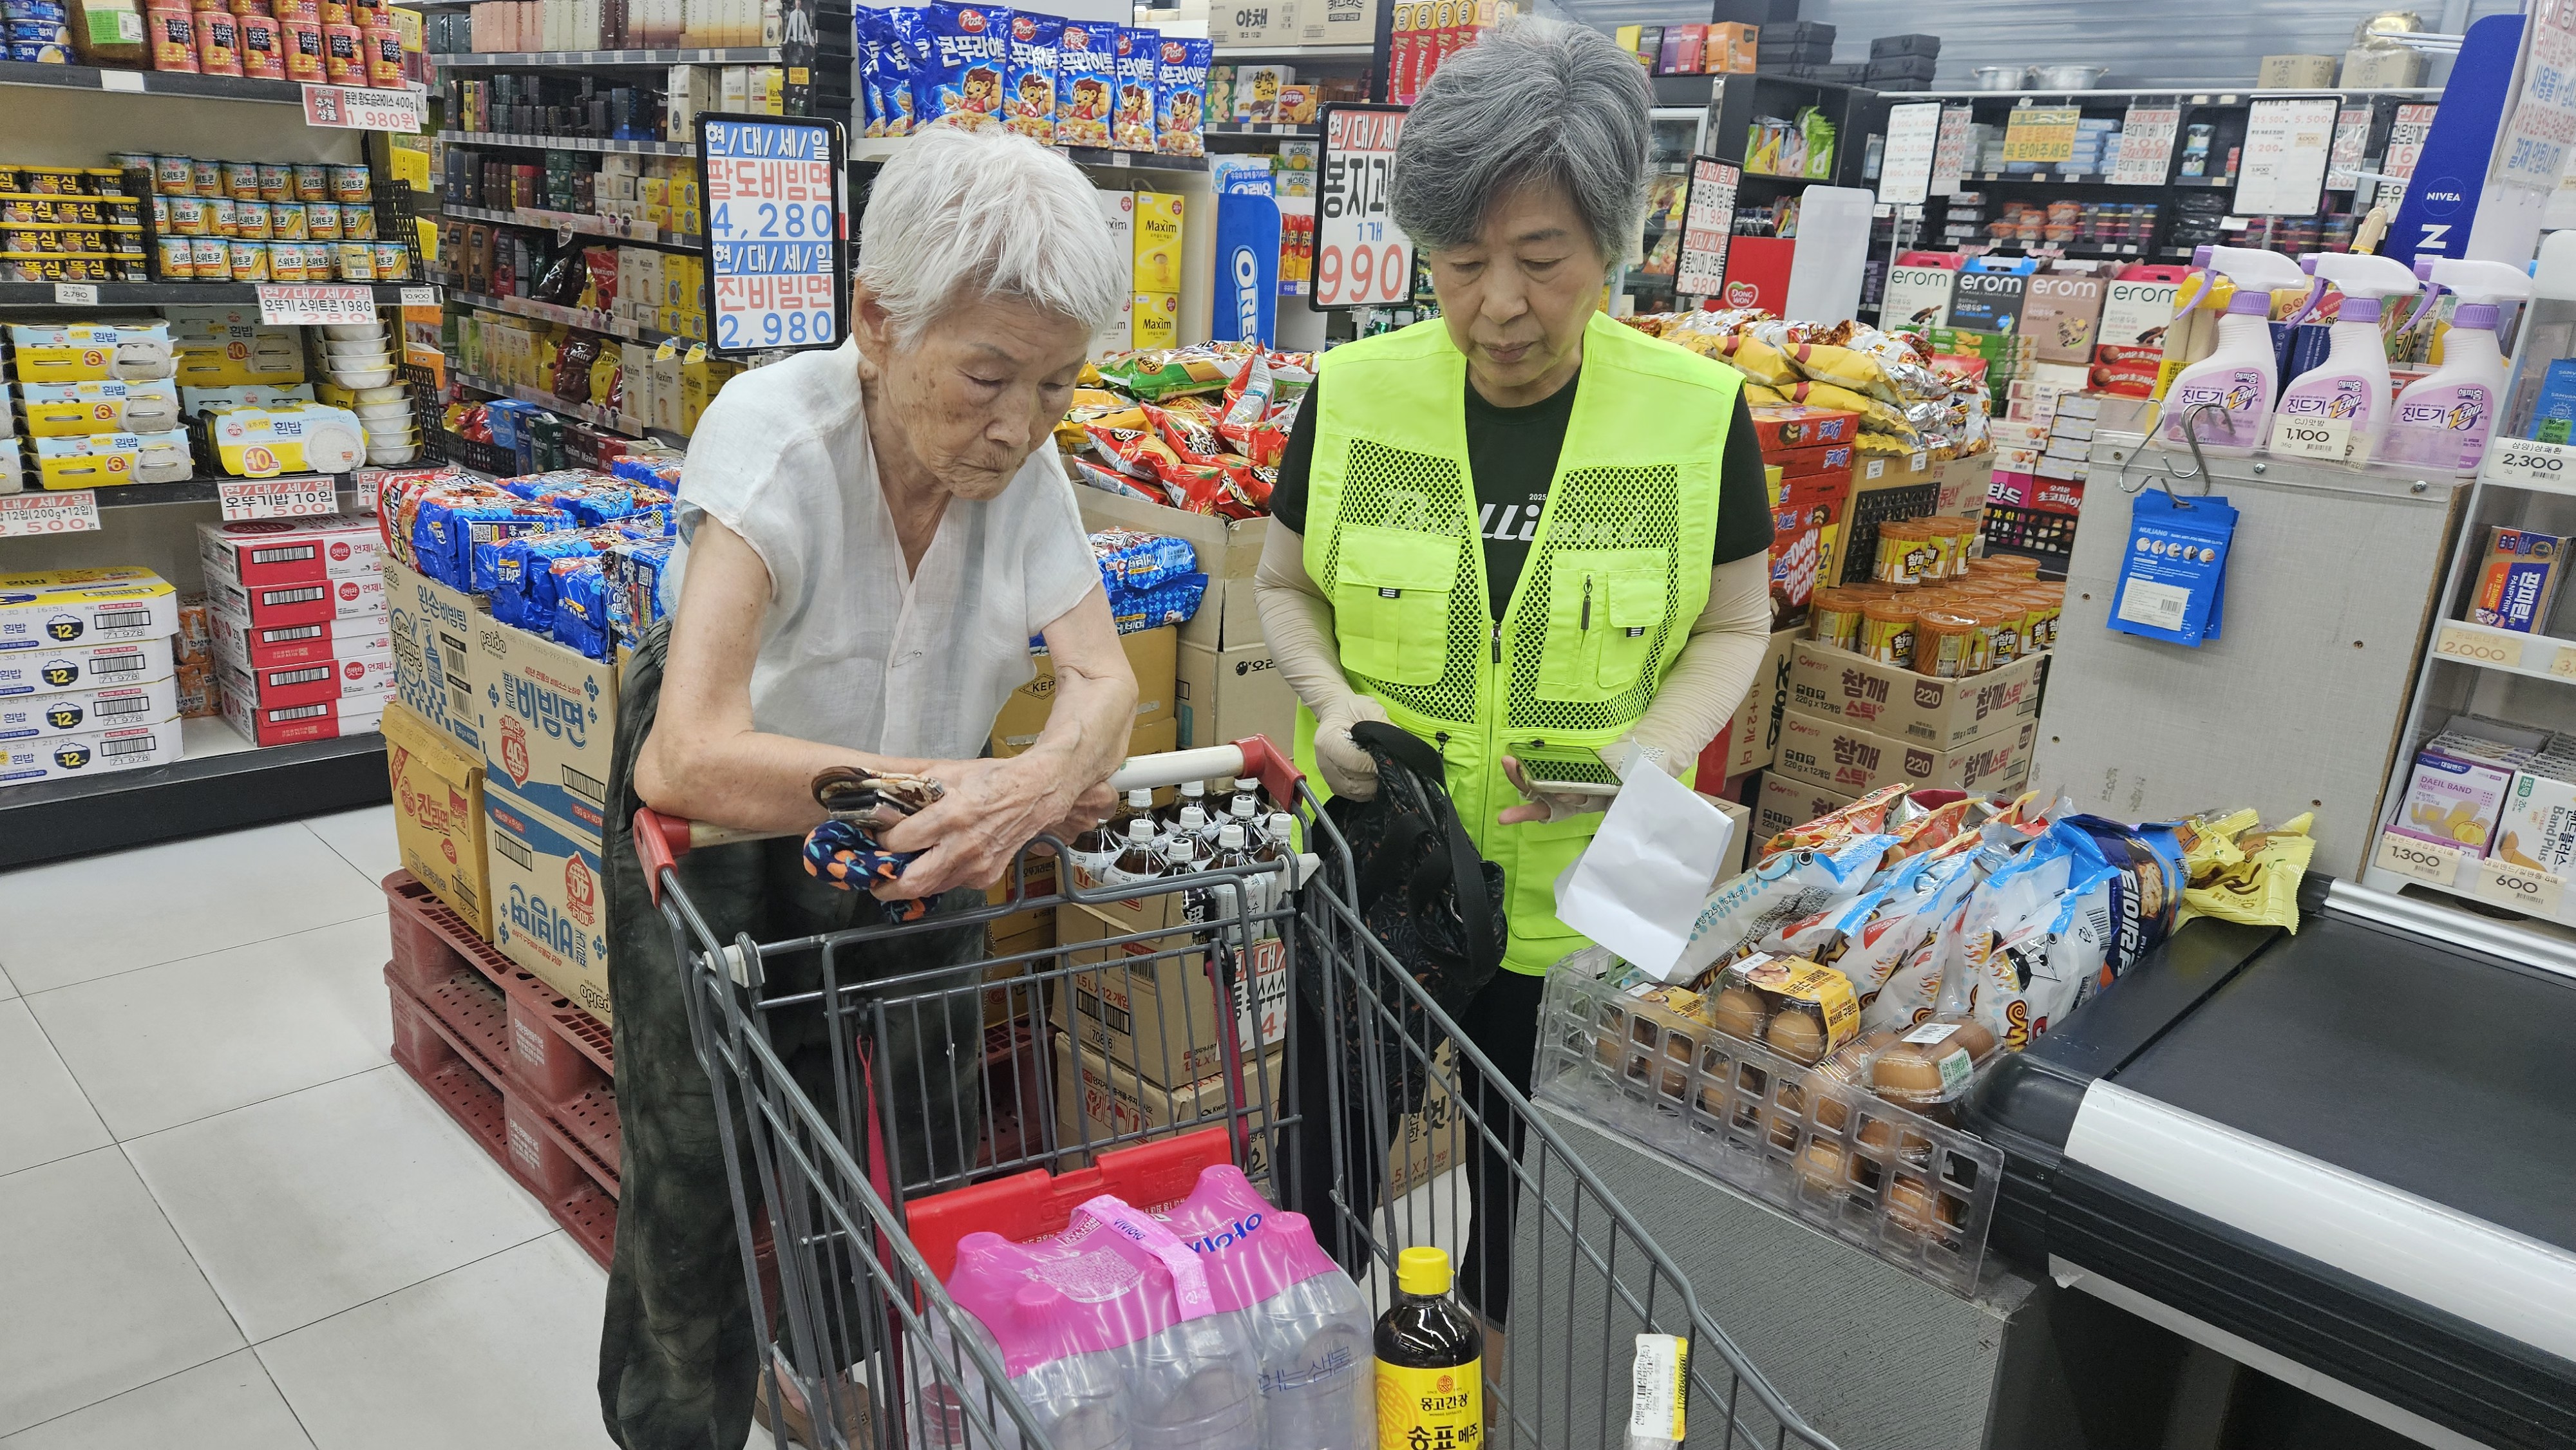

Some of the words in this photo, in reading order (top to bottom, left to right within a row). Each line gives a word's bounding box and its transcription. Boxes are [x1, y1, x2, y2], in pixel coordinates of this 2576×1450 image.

[962, 14, 983, 28] Post
[1236, 8, 1267, 28] 야채
[1014, 23, 1034, 35] Post
[1064, 32, 1085, 45] Post
[940, 35, 1006, 68] 콘푸라이트
[1163, 46, 1184, 59] Post
[314, 97, 336, 108] 추천
[345, 91, 357, 105] 동원
[358, 91, 394, 107] 황도슬라이스
[395, 98, 413, 112] 400g
[317, 109, 337, 122] 상품
[346, 110, 417, 131] 1,980원
[2294, 115, 2329, 123] 5,500
[705, 122, 829, 161] 현/대/세/일
[2247, 143, 2280, 153] 5,200
[2018, 142, 2070, 158] 닫아주세요
[43, 174, 76, 191] 뚝심
[161, 171, 186, 182] 스위트콘
[341, 178, 364, 189] 스위트콘
[708, 159, 832, 202] 팔도비빔면
[2426, 191, 2461, 202] NIVEA
[15, 202, 53, 219] 뚝심
[61, 202, 97, 220] 뚝심
[174, 210, 199, 221] 스위트콘
[1700, 207, 1728, 225] 1,980
[711, 202, 832, 240] 4,280
[1145, 219, 1177, 234] Maxim
[1357, 221, 1383, 241] 1개
[19, 232, 57, 248] 뚝심
[66, 232, 100, 249] 뚝심
[713, 242, 833, 274] 현/대/세/일
[24, 260, 61, 276] 뚝심
[1318, 243, 1404, 304] 990
[1891, 269, 1947, 288] erom
[1960, 274, 2022, 294] erom
[261, 286, 370, 300] 현/대/세/일
[716, 274, 832, 312] 진비빔면
[1730, 288, 1754, 299] DONG
[2031, 278, 2098, 299] erom
[2114, 285, 2178, 303] erom
[265, 299, 296, 312] 오뚜기
[299, 299, 339, 313] 스위트콘
[341, 300, 371, 312] 198G
[719, 310, 832, 348] 2,980
[1142, 316, 1172, 330] Maxim
[93, 331, 117, 343] 흰밥
[87, 351, 99, 366] 6
[655, 372, 673, 384] Maxim
[685, 375, 701, 390] Maxim
[2234, 371, 2259, 384] 해피홈
[102, 385, 126, 396] 흰밥
[2337, 379, 2362, 393] 해피홈
[2458, 388, 2483, 400] 해피홈
[2182, 388, 2223, 404] 진드기
[2226, 386, 2259, 410] ZERO
[97, 405, 109, 420] 6
[2287, 397, 2326, 414] 진드기
[2328, 395, 2362, 419] ZERO
[2401, 405, 2445, 424] 진드기
[2447, 402, 2483, 430] ZERO
[274, 420, 302, 435] 흰밥
[2286, 428, 2330, 443] 1,100
[114, 437, 138, 448] 흰밥
[111, 457, 123, 471] 6
[247, 451, 269, 469] 10
[581, 451, 598, 466] Maxim
[2502, 453, 2564, 471] 2,300
[223, 480, 331, 496] 현/대/세/일
[2049, 484, 2070, 493] 오리온
[225, 494, 290, 509] 오뚜기밥
[294, 491, 333, 504] 10입
[1529, 493, 1546, 501] 2025
[2037, 491, 2081, 509] 초코파이
[227, 503, 327, 519] 11,500
[2139, 526, 2169, 537] NULIANG
[331, 547, 349, 558] 햇반
[340, 587, 358, 597] 햇반
[2501, 574, 2519, 612] PANPYRIN
[2510, 572, 2541, 620] 판피린
[3, 623, 26, 634] 흰밥
[56, 625, 73, 638] 12
[480, 630, 507, 654] paldo
[2443, 641, 2506, 661] 2,000
[51, 670, 68, 684] 12
[345, 666, 363, 676] 햇반
[1841, 668, 1890, 704] 참깨
[1916, 686, 1941, 705] 220
[515, 675, 587, 749] 비빔면
[1819, 700, 1842, 715] 12개입
[1844, 700, 1877, 722] 스틱
[3, 711, 26, 722] 흰밥
[55, 712, 73, 726] 12
[2019, 729, 2031, 746] 220
[12, 753, 34, 765] 흰밥
[63, 753, 80, 766] 12
[1832, 735, 1882, 771] 참깨
[1808, 766, 1831, 780] 12개입
[1906, 756, 1931, 775] 220
[2441, 761, 2467, 772] 대일밴드
[1835, 766, 1868, 789] 스틱
[2421, 775, 2446, 790] DAEIL
[2447, 782, 2472, 795] BAND
[2418, 782, 2435, 792] NEW
[417, 793, 450, 836] 진라면
[2545, 805, 2566, 837] Band
[2537, 830, 2556, 863] Plus
[2391, 845, 2440, 867] 1,300
[2495, 874, 2539, 894] 600
[509, 882, 574, 960] 비빔면
[580, 983, 611, 1012] paldo
[1420, 1393, 1468, 1412] 몽고간장
[1406, 1425, 1456, 1450] 송표
[1457, 1422, 1479, 1444] 메주
